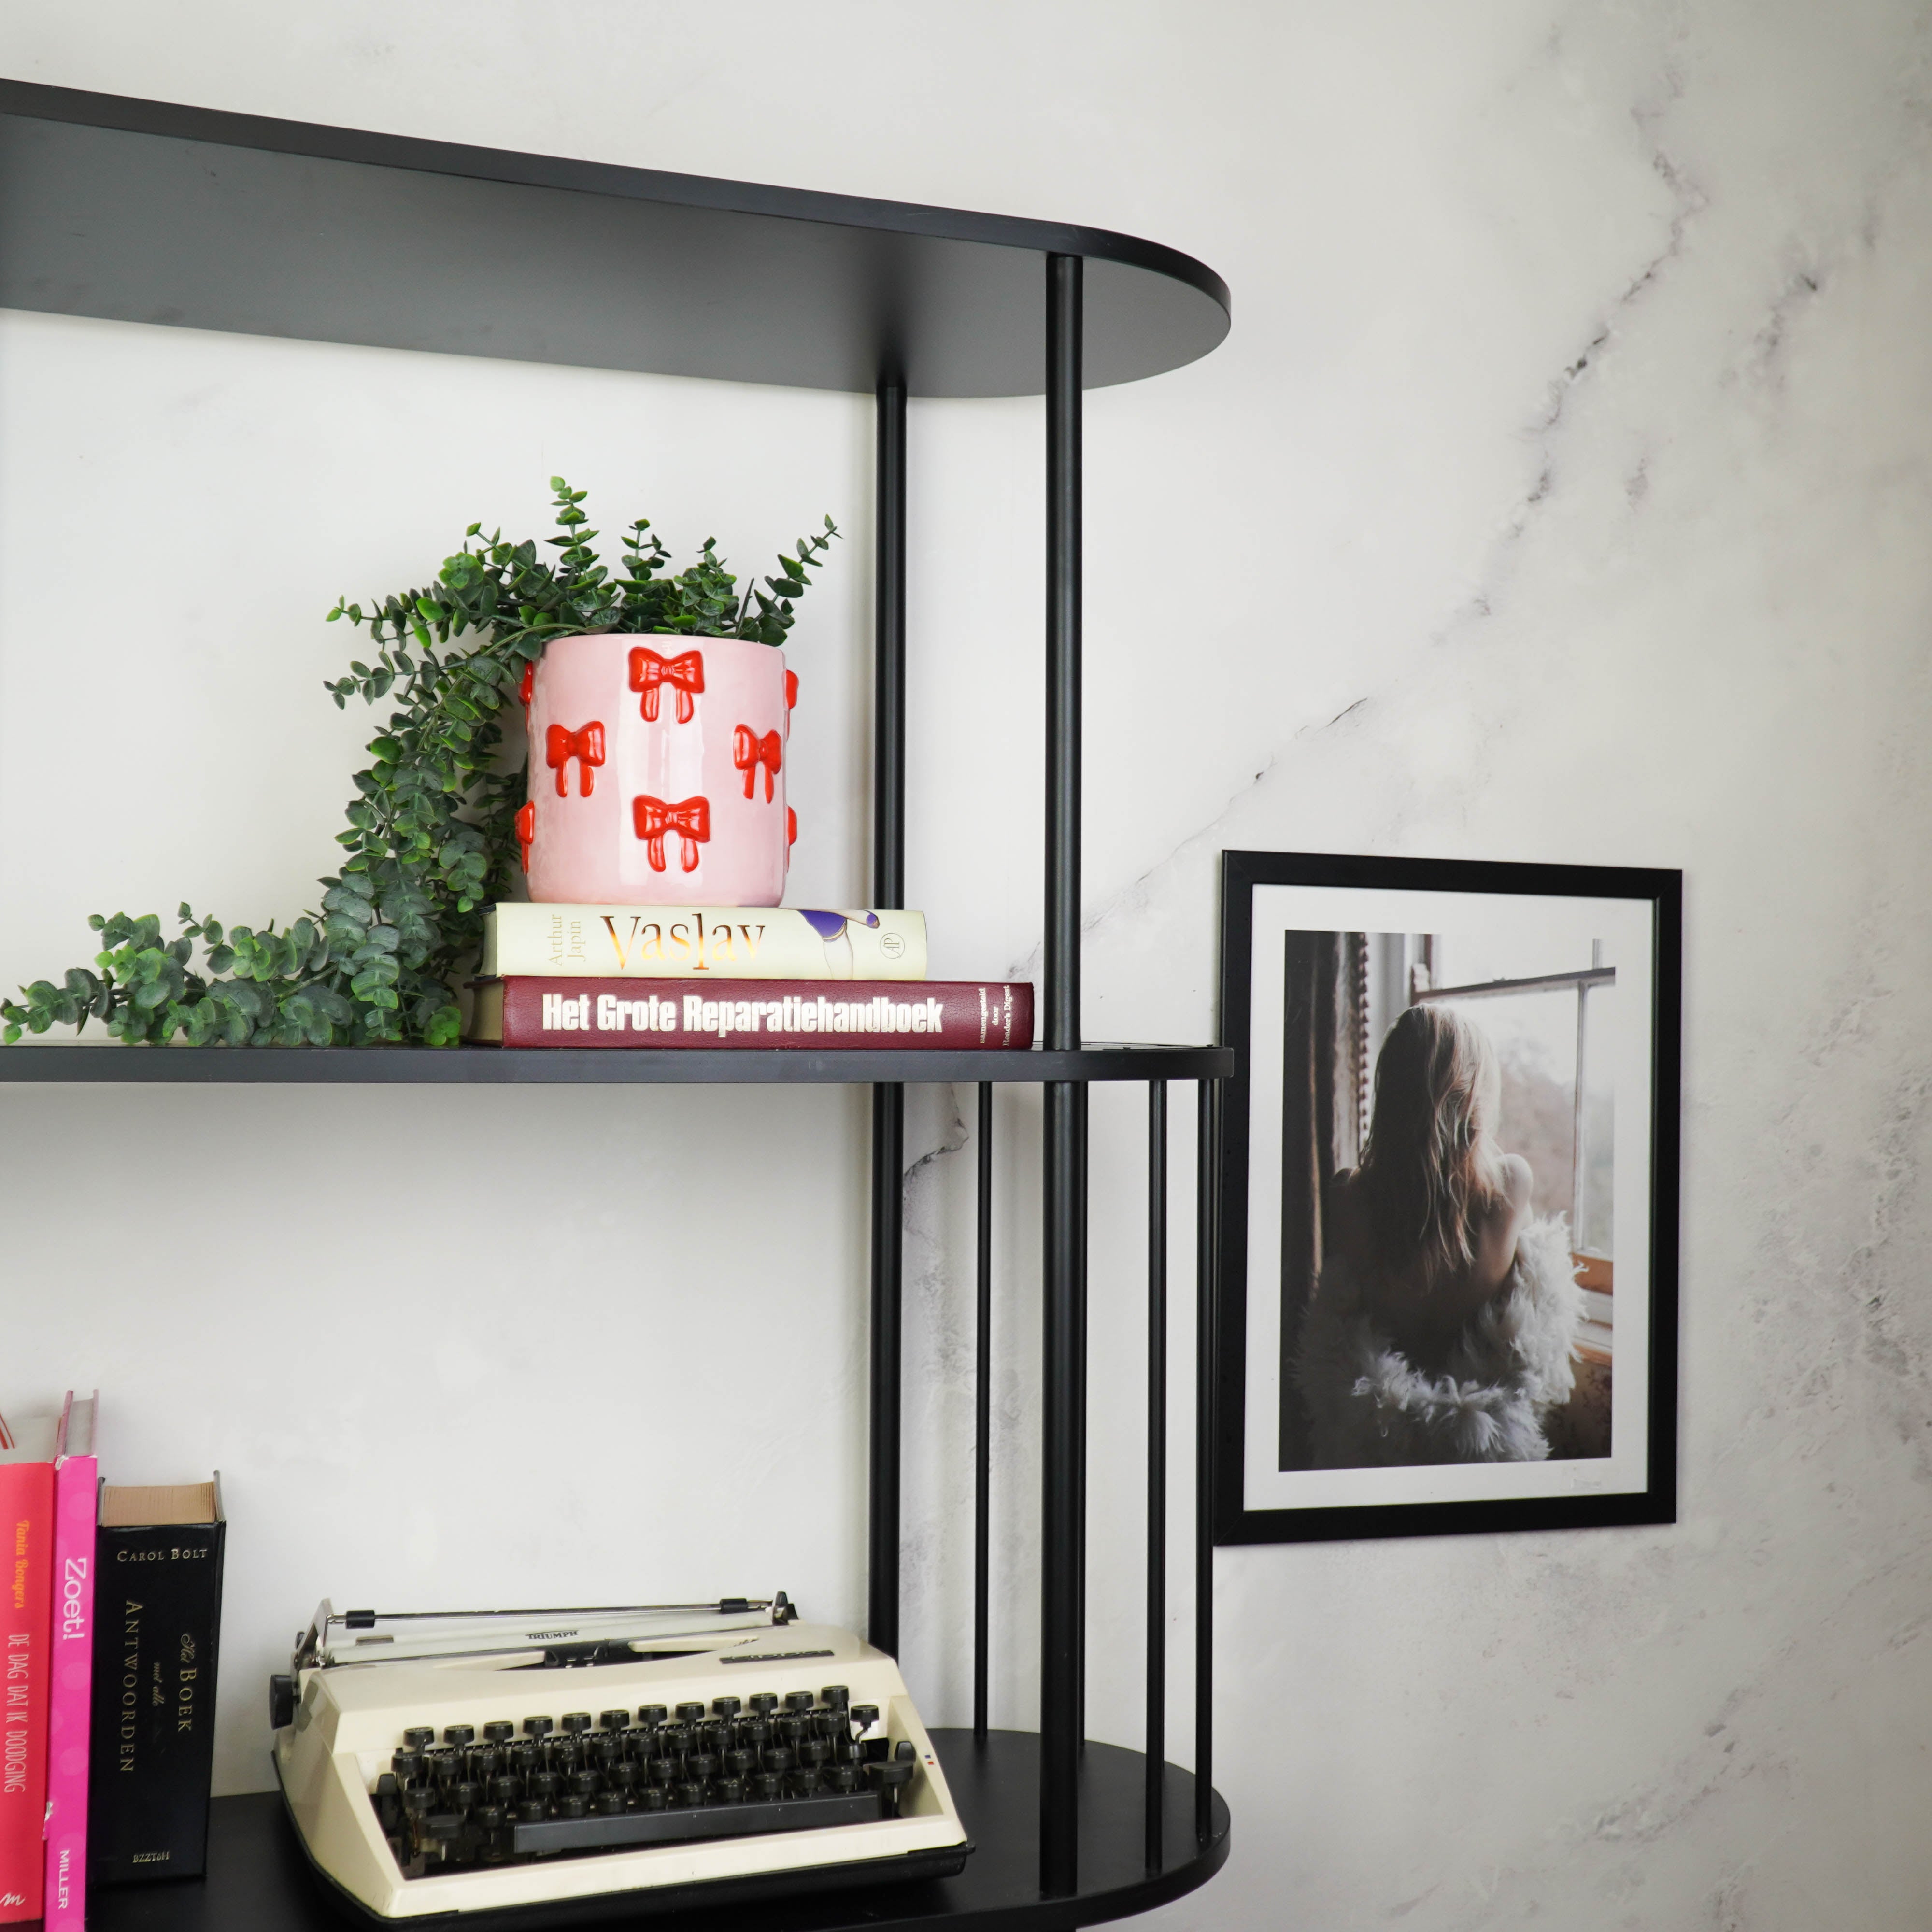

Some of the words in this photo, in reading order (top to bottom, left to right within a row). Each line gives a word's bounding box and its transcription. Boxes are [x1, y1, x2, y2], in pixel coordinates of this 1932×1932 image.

[547, 914, 562, 966] Arthur
[567, 921, 586, 962] Japin
[600, 912, 766, 970] Vaslav
[542, 994, 590, 1031] Het
[597, 994, 676, 1032] Grote
[682, 995, 944, 1038] Reparatiehandboek
[1003, 985, 1013, 1011] Digest
[15, 1520, 30, 1556] Tania
[11, 1559, 29, 1609] Bongers
[63, 1557, 87, 1640] Zoet!
[7, 1634, 29, 1648] DE
[525, 1630, 579, 1640] TRIUMPH
[7, 1653, 29, 1680] DAG
[119, 1599, 143, 1773] ANTWOORDEN
[6, 1685, 29, 1706] DAT
[6, 1711, 28, 1723] IK
[177, 1667, 197, 1732] BOEK
[4, 1730, 28, 1793] DOODGING
[58, 1849, 70, 1910] MILLER
